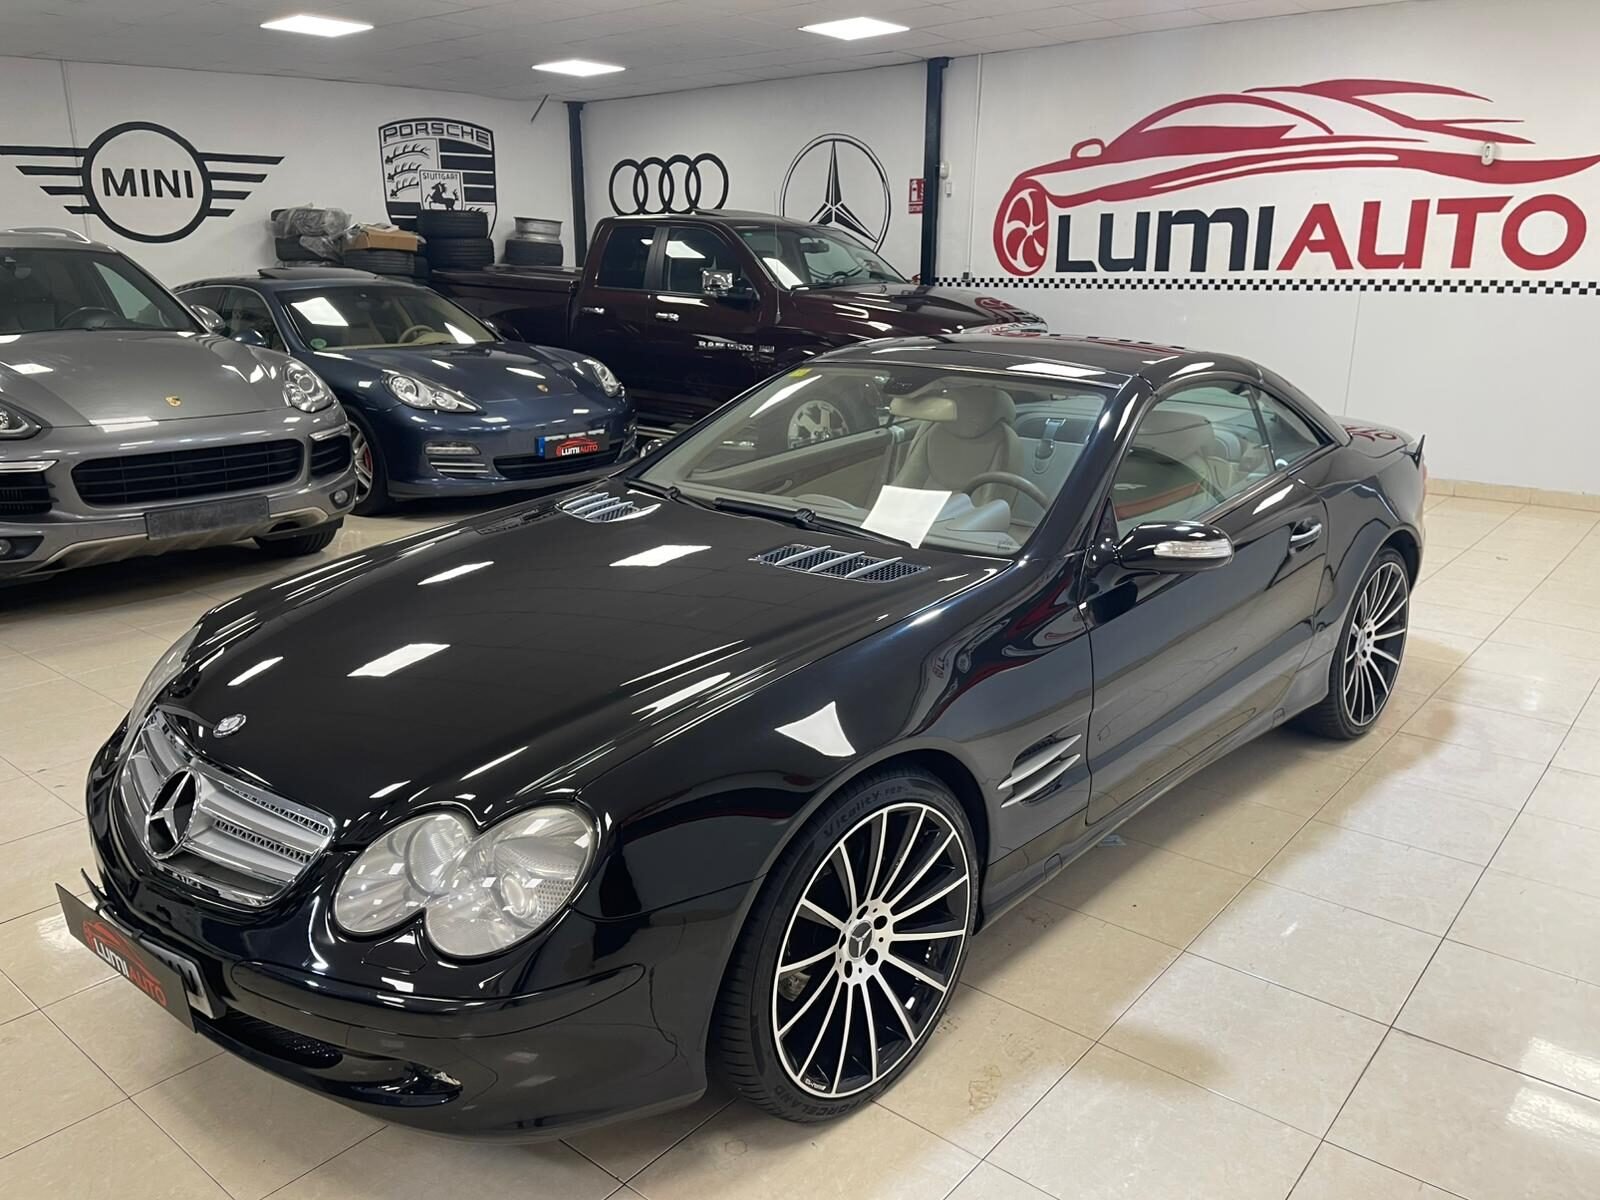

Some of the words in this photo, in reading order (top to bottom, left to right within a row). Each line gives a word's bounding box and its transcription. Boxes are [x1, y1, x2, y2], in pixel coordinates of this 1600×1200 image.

[383, 122, 489, 146] PORSCHE
[102, 168, 194, 198] MINI
[422, 172, 459, 181] STUTTGART
